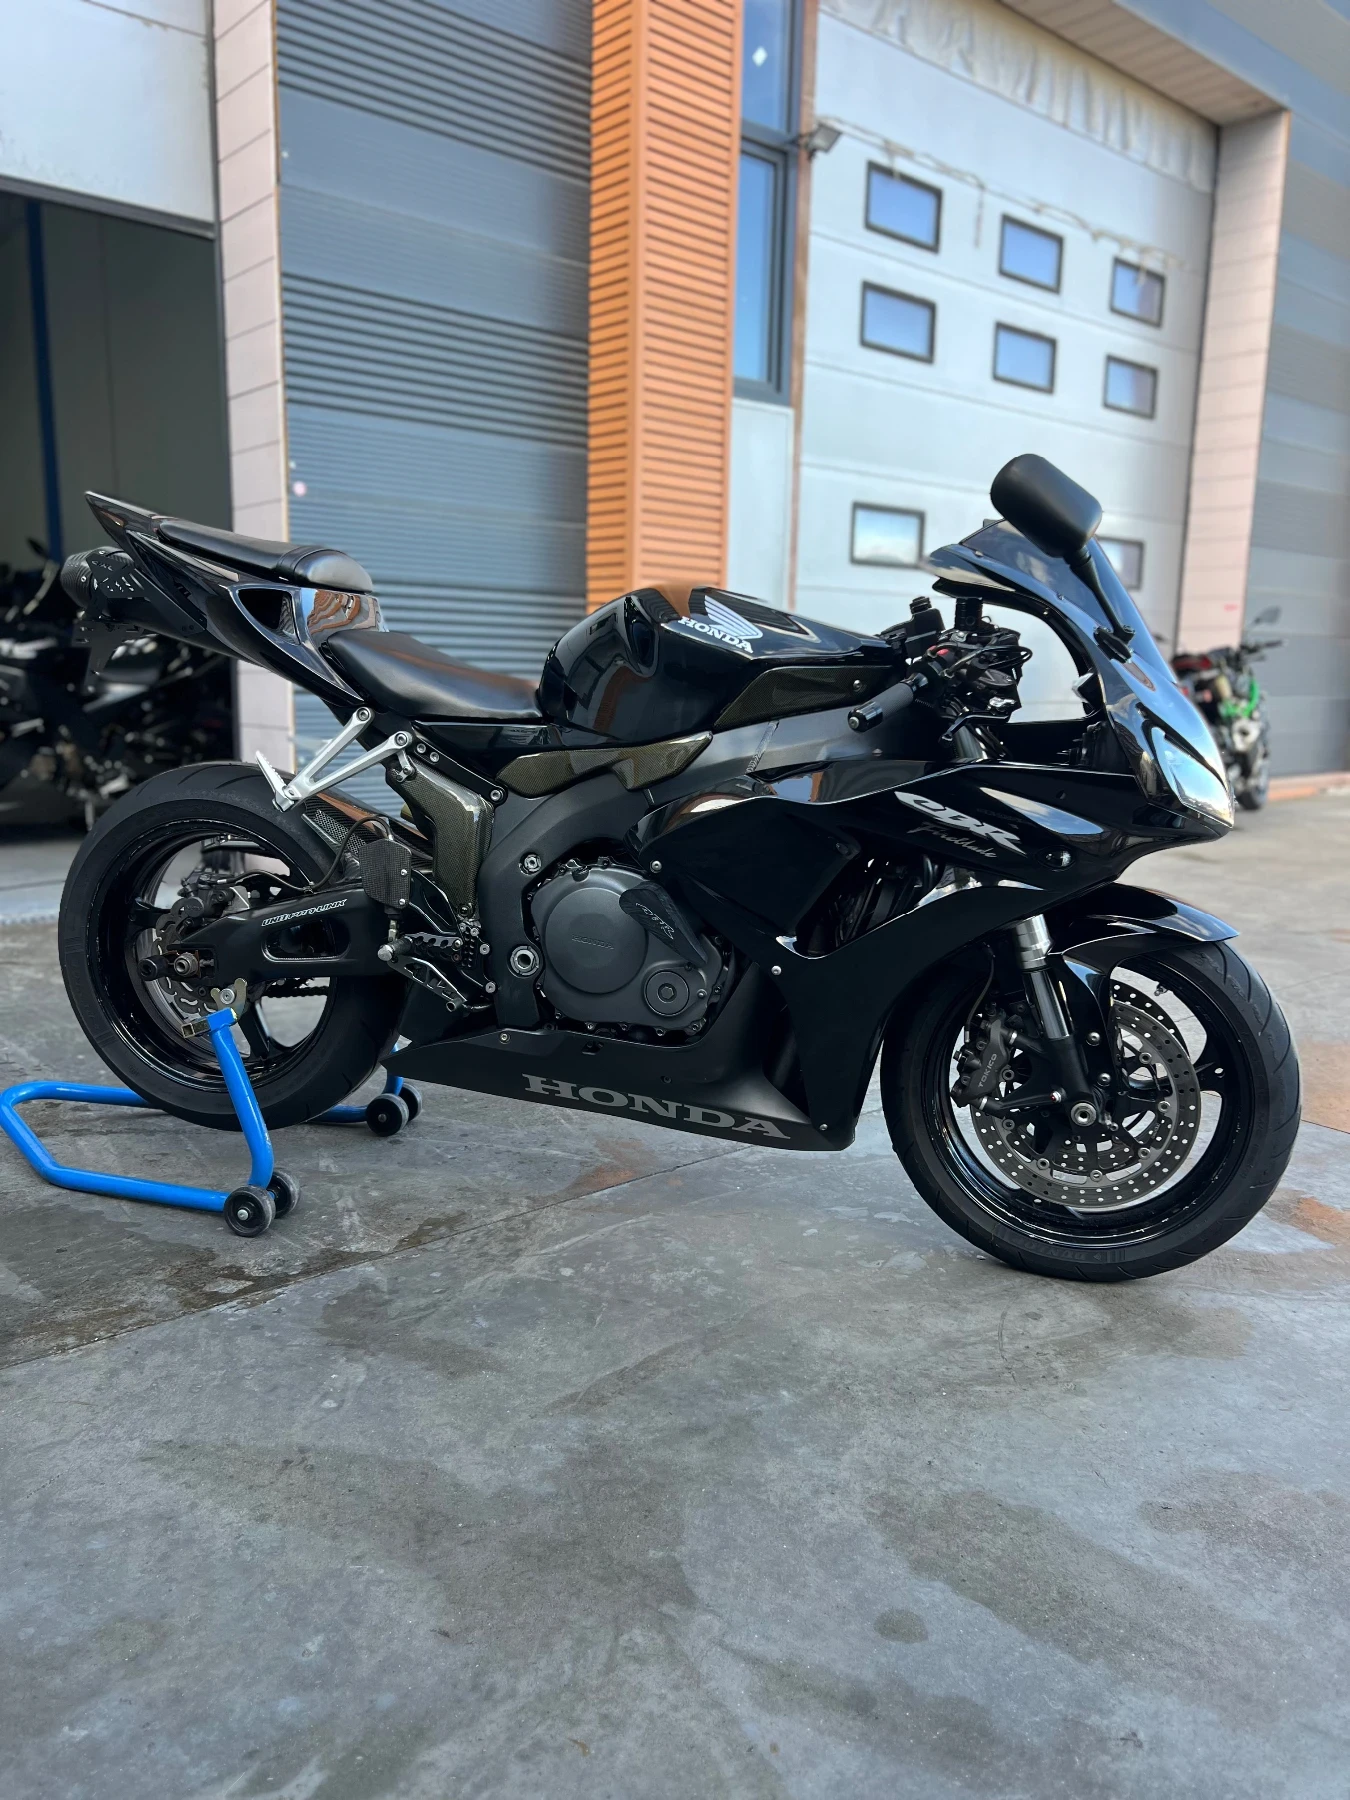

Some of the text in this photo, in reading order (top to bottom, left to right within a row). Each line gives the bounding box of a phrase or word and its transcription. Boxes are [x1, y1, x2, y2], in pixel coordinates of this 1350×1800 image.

[678, 616, 753, 653] HONDA
[894, 791, 1028, 858] CBR
[907, 821, 997, 858] Fireblade
[571, 934, 615, 950] HONDA
[978, 1053, 997, 1087] TOKICO
[522, 1073, 791, 1140] HONDA
